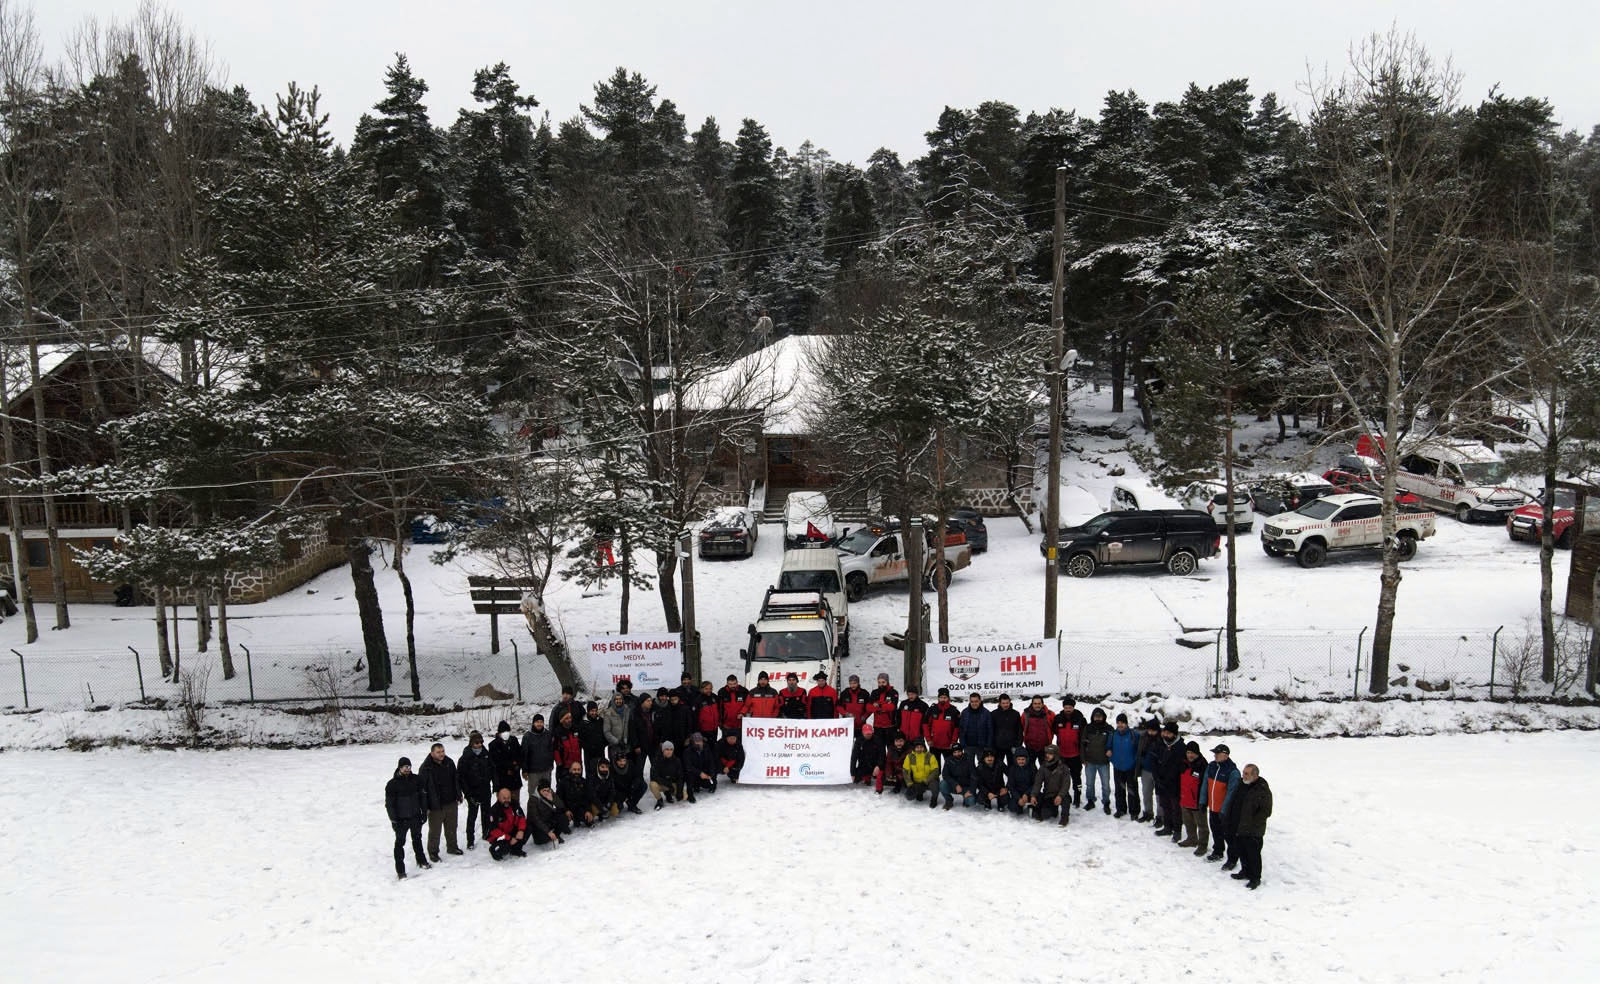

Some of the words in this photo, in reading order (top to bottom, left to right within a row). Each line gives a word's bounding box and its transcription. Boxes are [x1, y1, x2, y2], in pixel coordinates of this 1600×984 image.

[592, 643, 607, 653] KIŞ
[609, 640, 643, 652] EĞİTİM
[645, 641, 677, 650] KAMPI
[941, 645, 971, 653] BOLU
[976, 641, 1043, 653] ALADAĞLAR
[944, 683, 965, 691] 2020
[968, 683, 982, 691] KIŞ
[984, 680, 1014, 690] EĞİTİM
[1015, 680, 1044, 688] KAMPI
[746, 728, 765, 740] KIŞ
[768, 726, 808, 738] EĞİTİM
[811, 727, 848, 738] KAMPI
